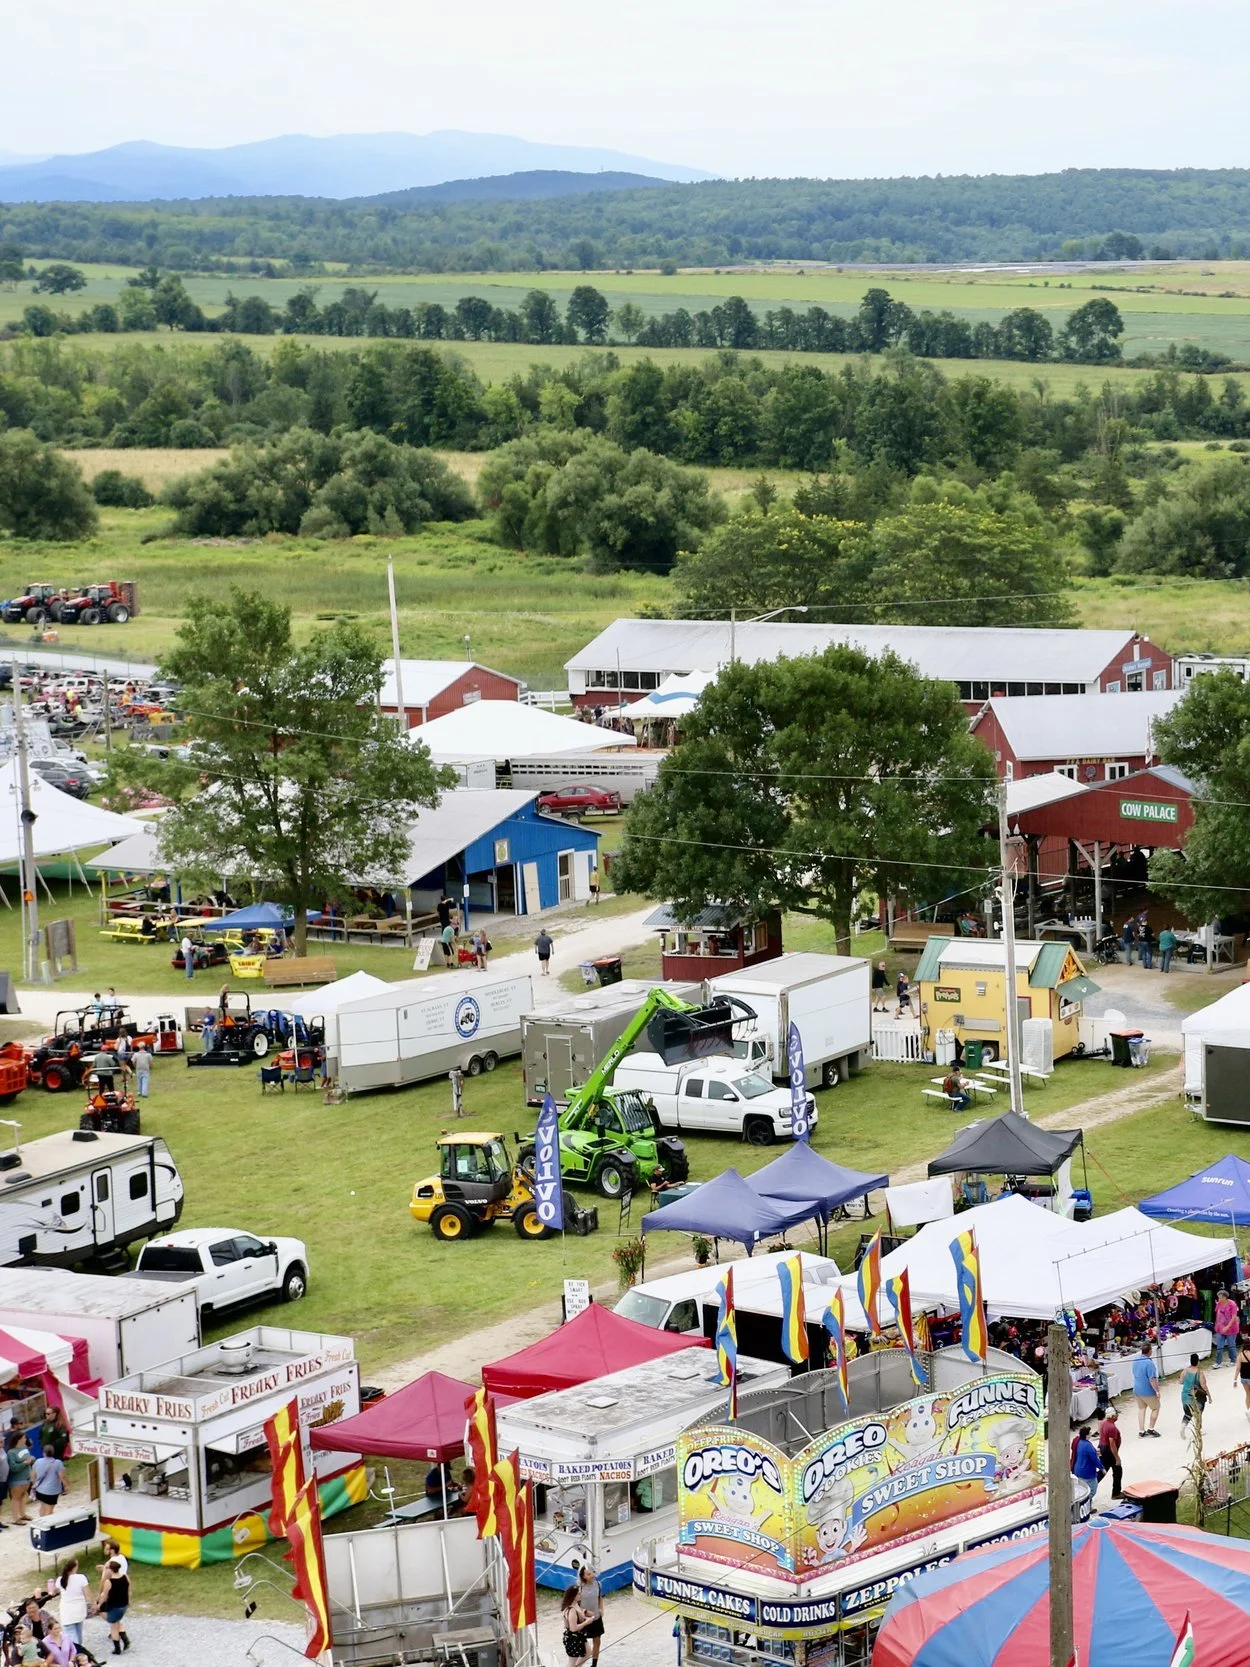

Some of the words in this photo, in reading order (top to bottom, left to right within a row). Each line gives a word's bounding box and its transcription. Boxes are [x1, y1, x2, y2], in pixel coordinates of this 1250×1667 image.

[1121, 803, 1141, 816] COW
[1144, 805, 1176, 820] PALACE
[601, 1049, 620, 1076] MERLO
[789, 1051, 808, 1136] VOLVO
[535, 1126, 556, 1221] VOLVO
[1200, 1176, 1235, 1186] sunrun
[200, 1402, 219, 1418] Fresh
[230, 1372, 280, 1405] FREAKY
[285, 1356, 322, 1384] FRIES
[330, 1381, 352, 1398] FRIES
[104, 1390, 150, 1414] FREAKY
[156, 1396, 192, 1418] FRIES
[949, 1382, 1040, 1428] FUNNEL
[960, 1402, 1026, 1427] CAKES
[305, 1410, 321, 1422] Fries
[78, 1442, 98, 1453] Fresh
[100, 1446, 111, 1455] Cut
[113, 1446, 134, 1458] French
[134, 1449, 150, 1460] Fries
[242, 1435, 263, 1449] Fresh
[687, 1437, 712, 1451] DEEP
[714, 1435, 744, 1445] FRIED
[520, 1459, 548, 1472] ATOES
[558, 1464, 590, 1474] BAKED
[592, 1460, 632, 1472] POTATOES
[644, 1448, 674, 1465] BAKED
[804, 1424, 886, 1504] OREO
[600, 1471, 632, 1480] NACHOS
[685, 1447, 784, 1492] OREO'S
[814, 1450, 883, 1502] COOKIES
[862, 1470, 931, 1514] SWEET
[934, 1458, 987, 1478] SHOP
[694, 1521, 740, 1539] SWEET
[742, 1531, 779, 1552] SHOP
[656, 1576, 707, 1603] FUNNEL
[708, 1590, 750, 1615] CAKES
[682, 1598, 710, 1610] GLAZED
[711, 1606, 742, 1618] TOPPING
[763, 1606, 790, 1622] COLD
[794, 1602, 836, 1622] DRINKS
